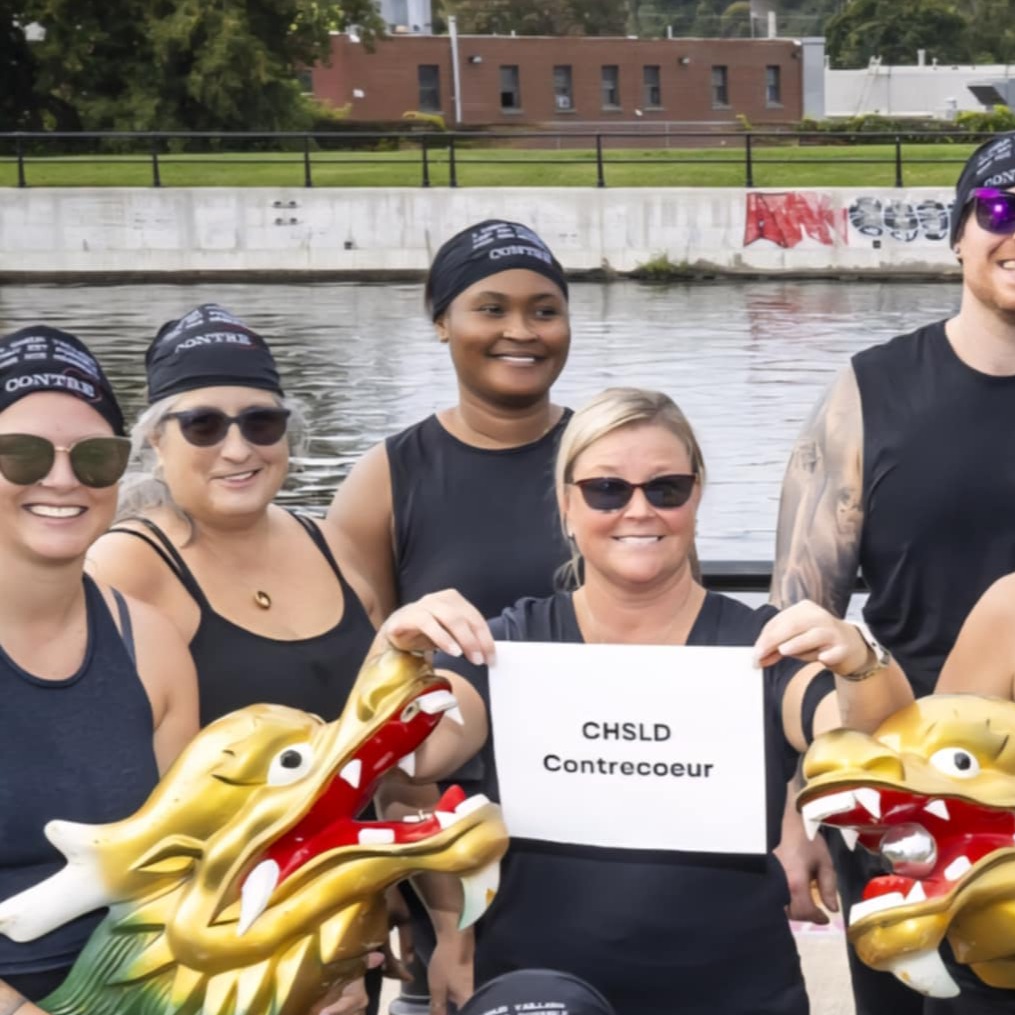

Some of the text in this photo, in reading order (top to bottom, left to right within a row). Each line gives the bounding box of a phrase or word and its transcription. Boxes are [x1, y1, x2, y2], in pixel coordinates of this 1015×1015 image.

[5, 372, 96, 398] CONTRE
[582, 721, 671, 742] CHSLD
[543, 753, 714, 778] Contrecoeur
